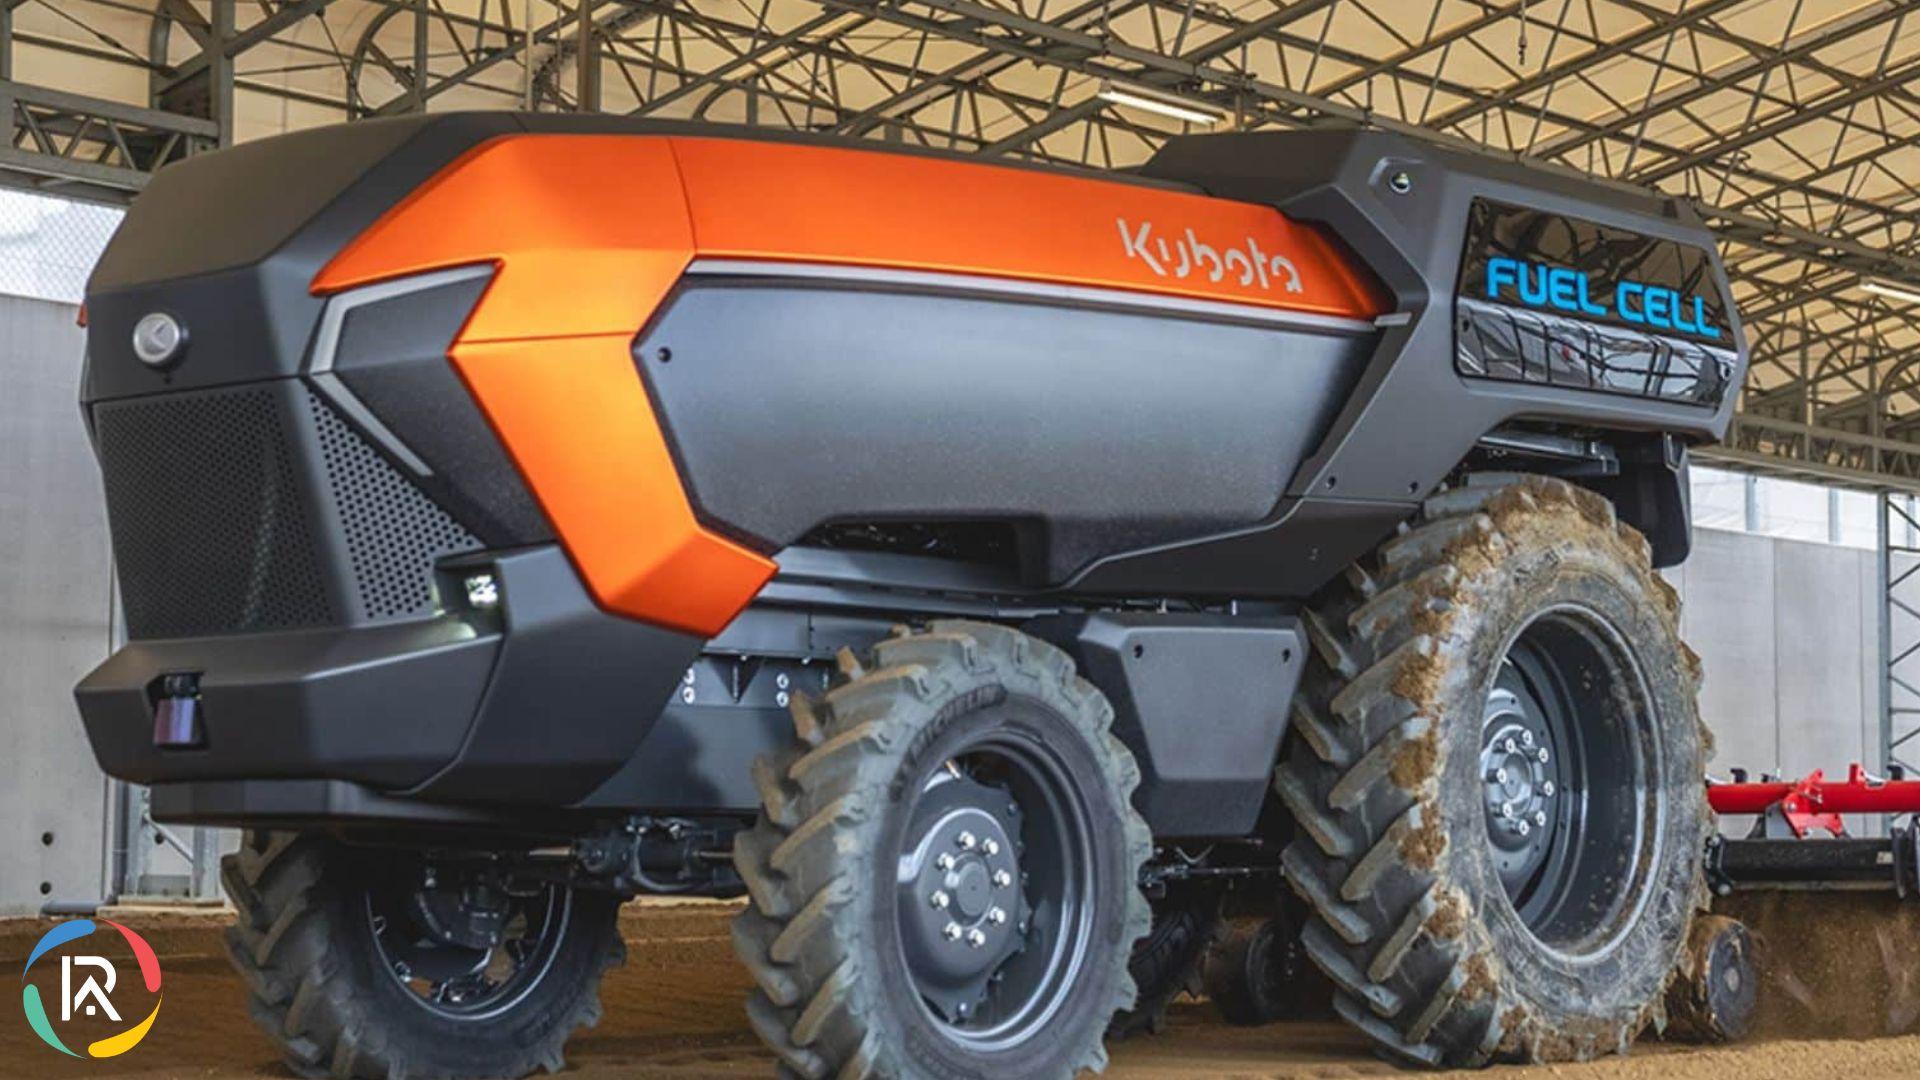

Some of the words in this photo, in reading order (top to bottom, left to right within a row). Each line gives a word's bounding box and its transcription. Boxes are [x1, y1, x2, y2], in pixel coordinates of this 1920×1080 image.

[1116, 217, 1303, 294] Kubota
[1487, 256, 1607, 317] FUEL
[1616, 280, 1720, 338] CELL
